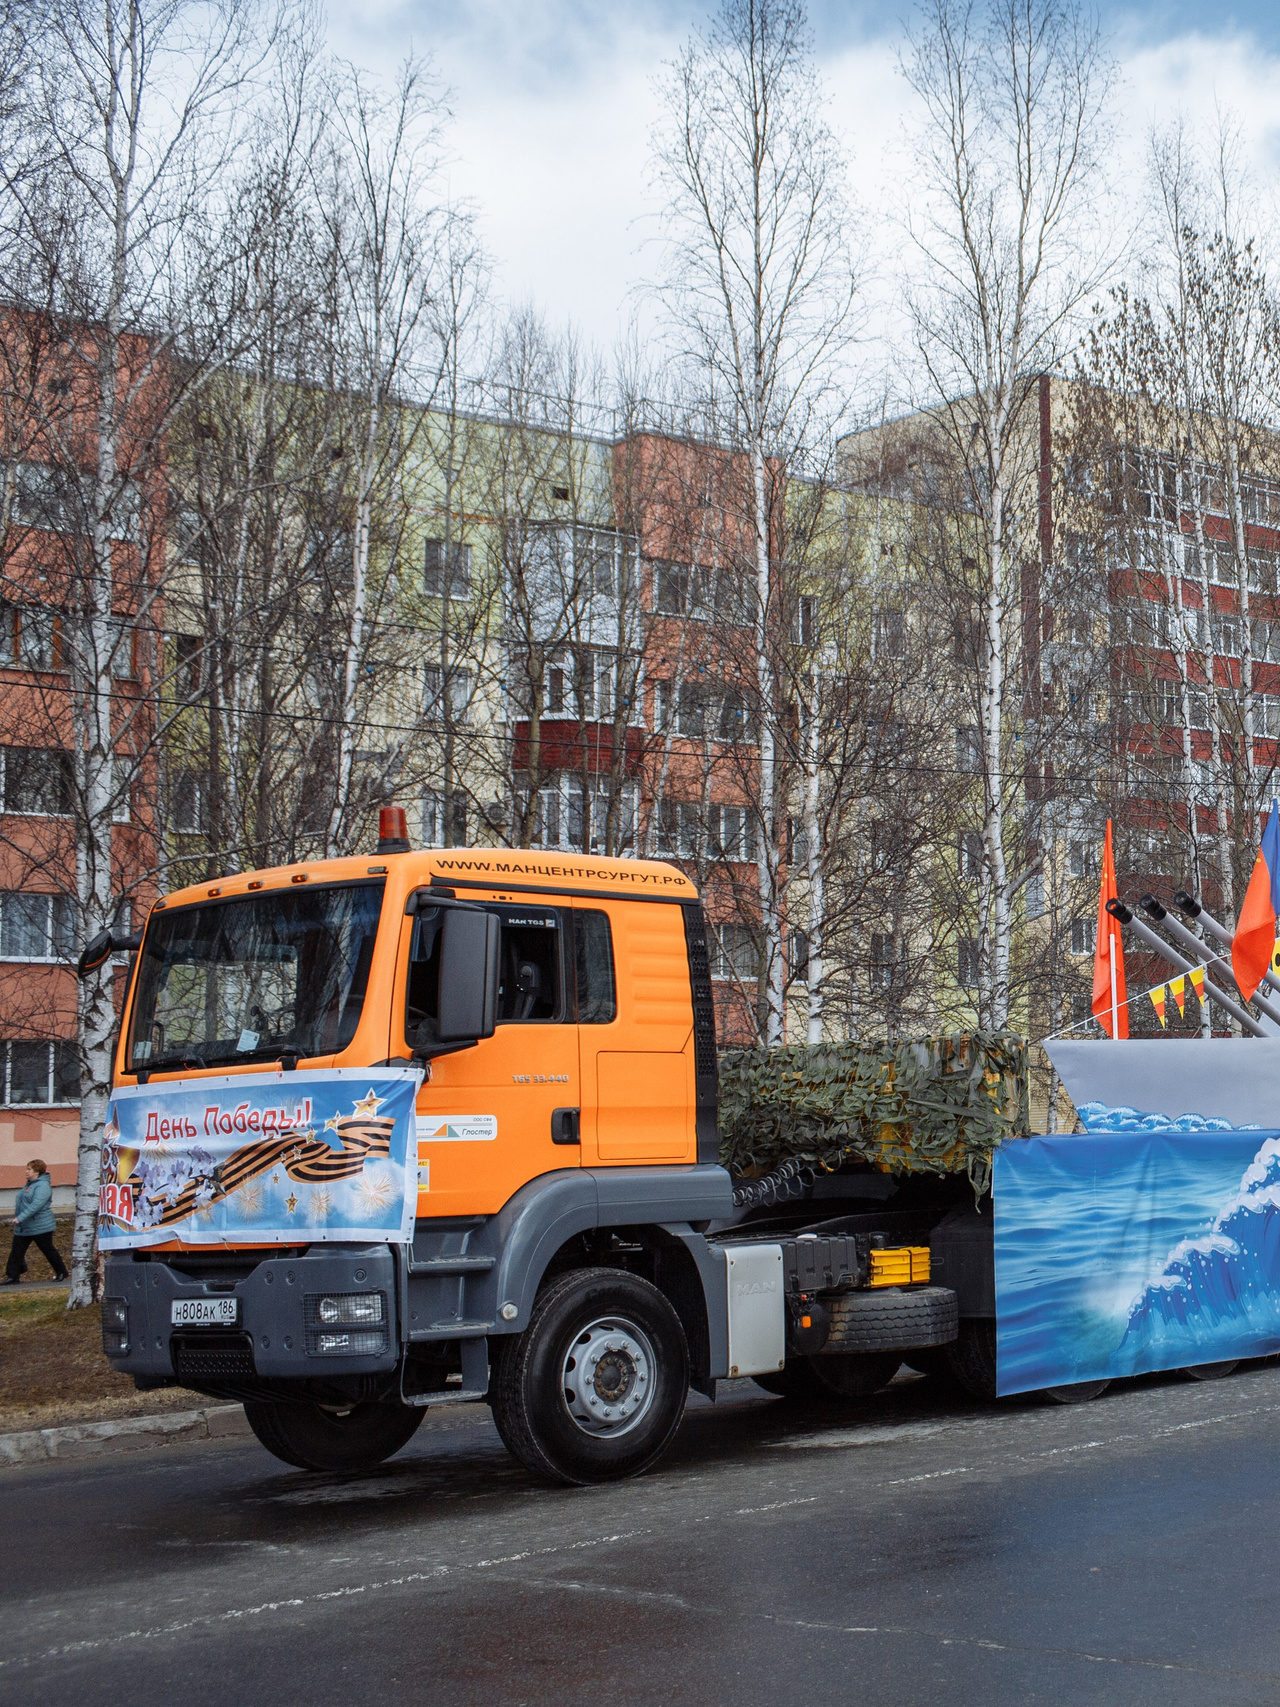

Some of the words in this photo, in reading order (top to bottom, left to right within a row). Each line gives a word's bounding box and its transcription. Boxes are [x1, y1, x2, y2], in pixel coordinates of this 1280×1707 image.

[436, 859, 687, 886] WWW.МАНЦЕНТРСУРГУТ.РФ
[533, 1074, 569, 1084] 33.440
[144, 1111, 198, 1145] День
[203, 1100, 312, 1137] Победы!
[462, 1128, 493, 1136] Глостер
[737, 1281, 777, 1297] MAN
[218, 1300, 234, 1315] 186
